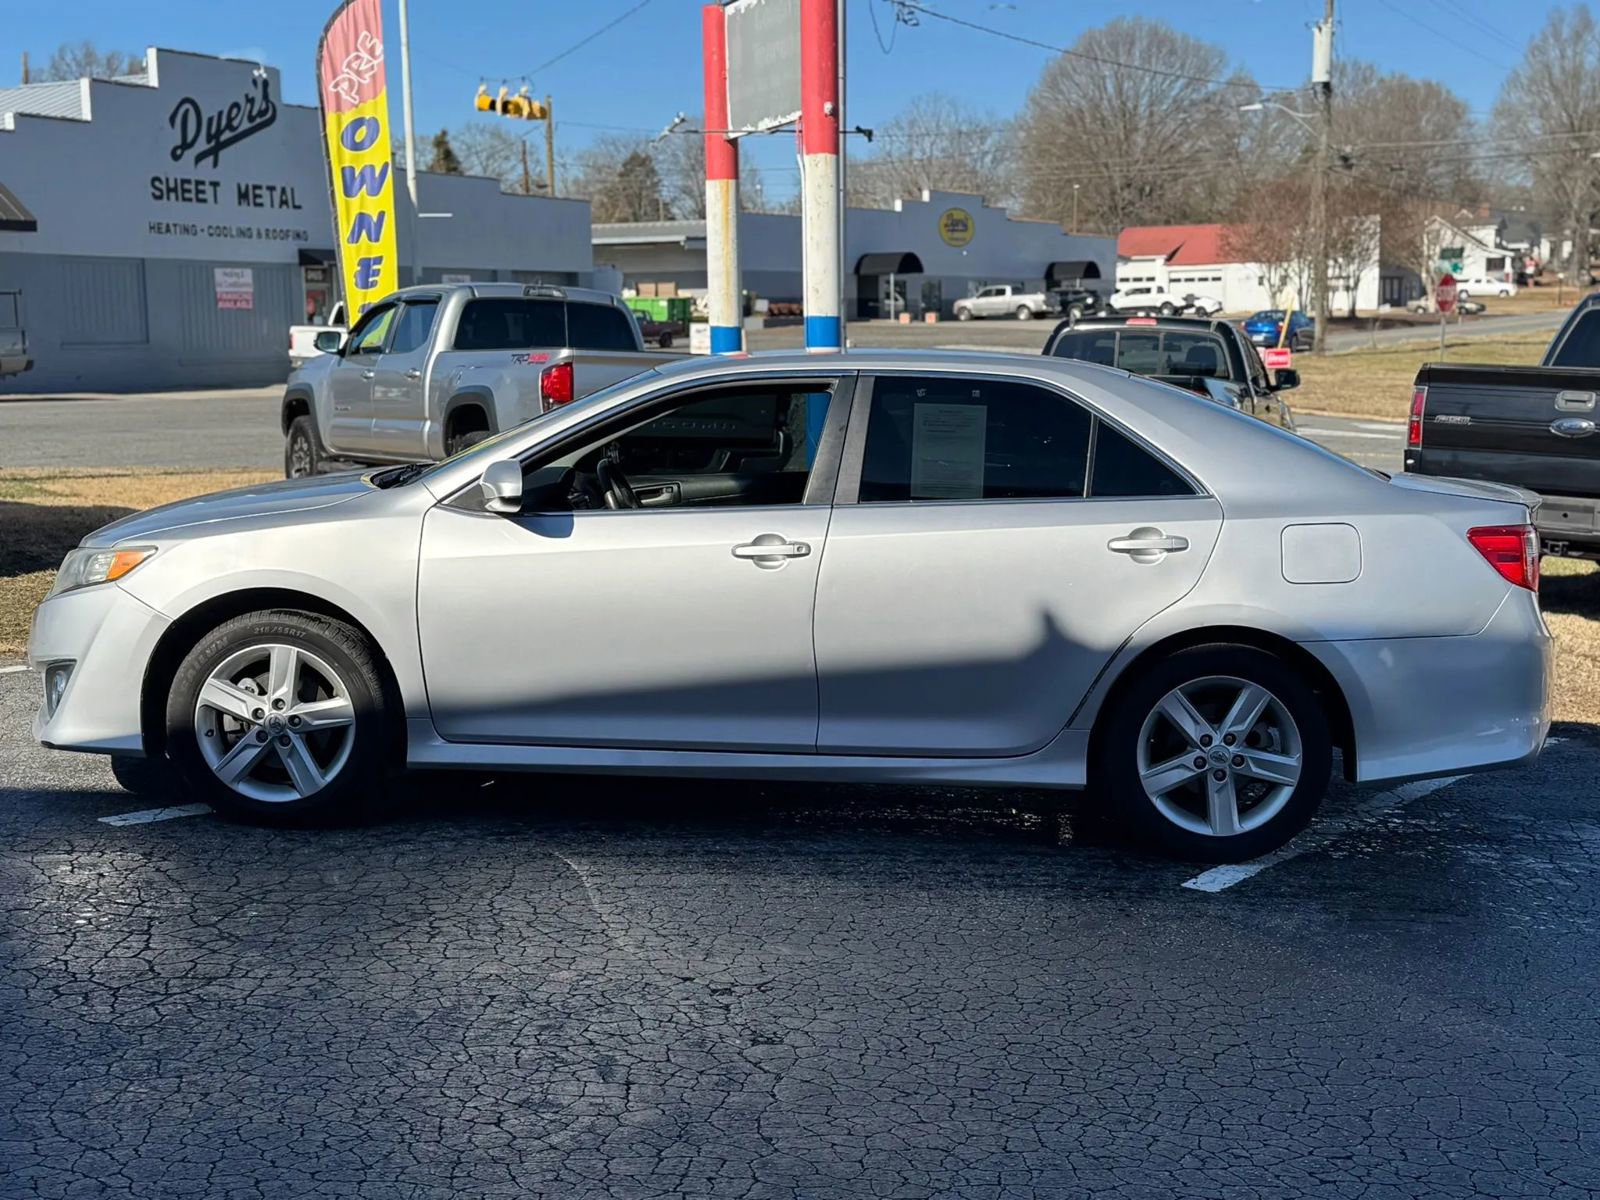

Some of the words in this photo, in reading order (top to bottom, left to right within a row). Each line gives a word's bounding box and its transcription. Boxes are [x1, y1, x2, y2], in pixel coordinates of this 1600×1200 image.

[330, 31, 384, 104] PRE
[169, 78, 277, 168] Dyer's
[151, 176, 220, 204] SHEET
[237, 183, 302, 209] METAL
[149, 222, 198, 237] HEATING
[207, 225, 253, 239] COOLING
[265, 228, 309, 242] ROOFING
